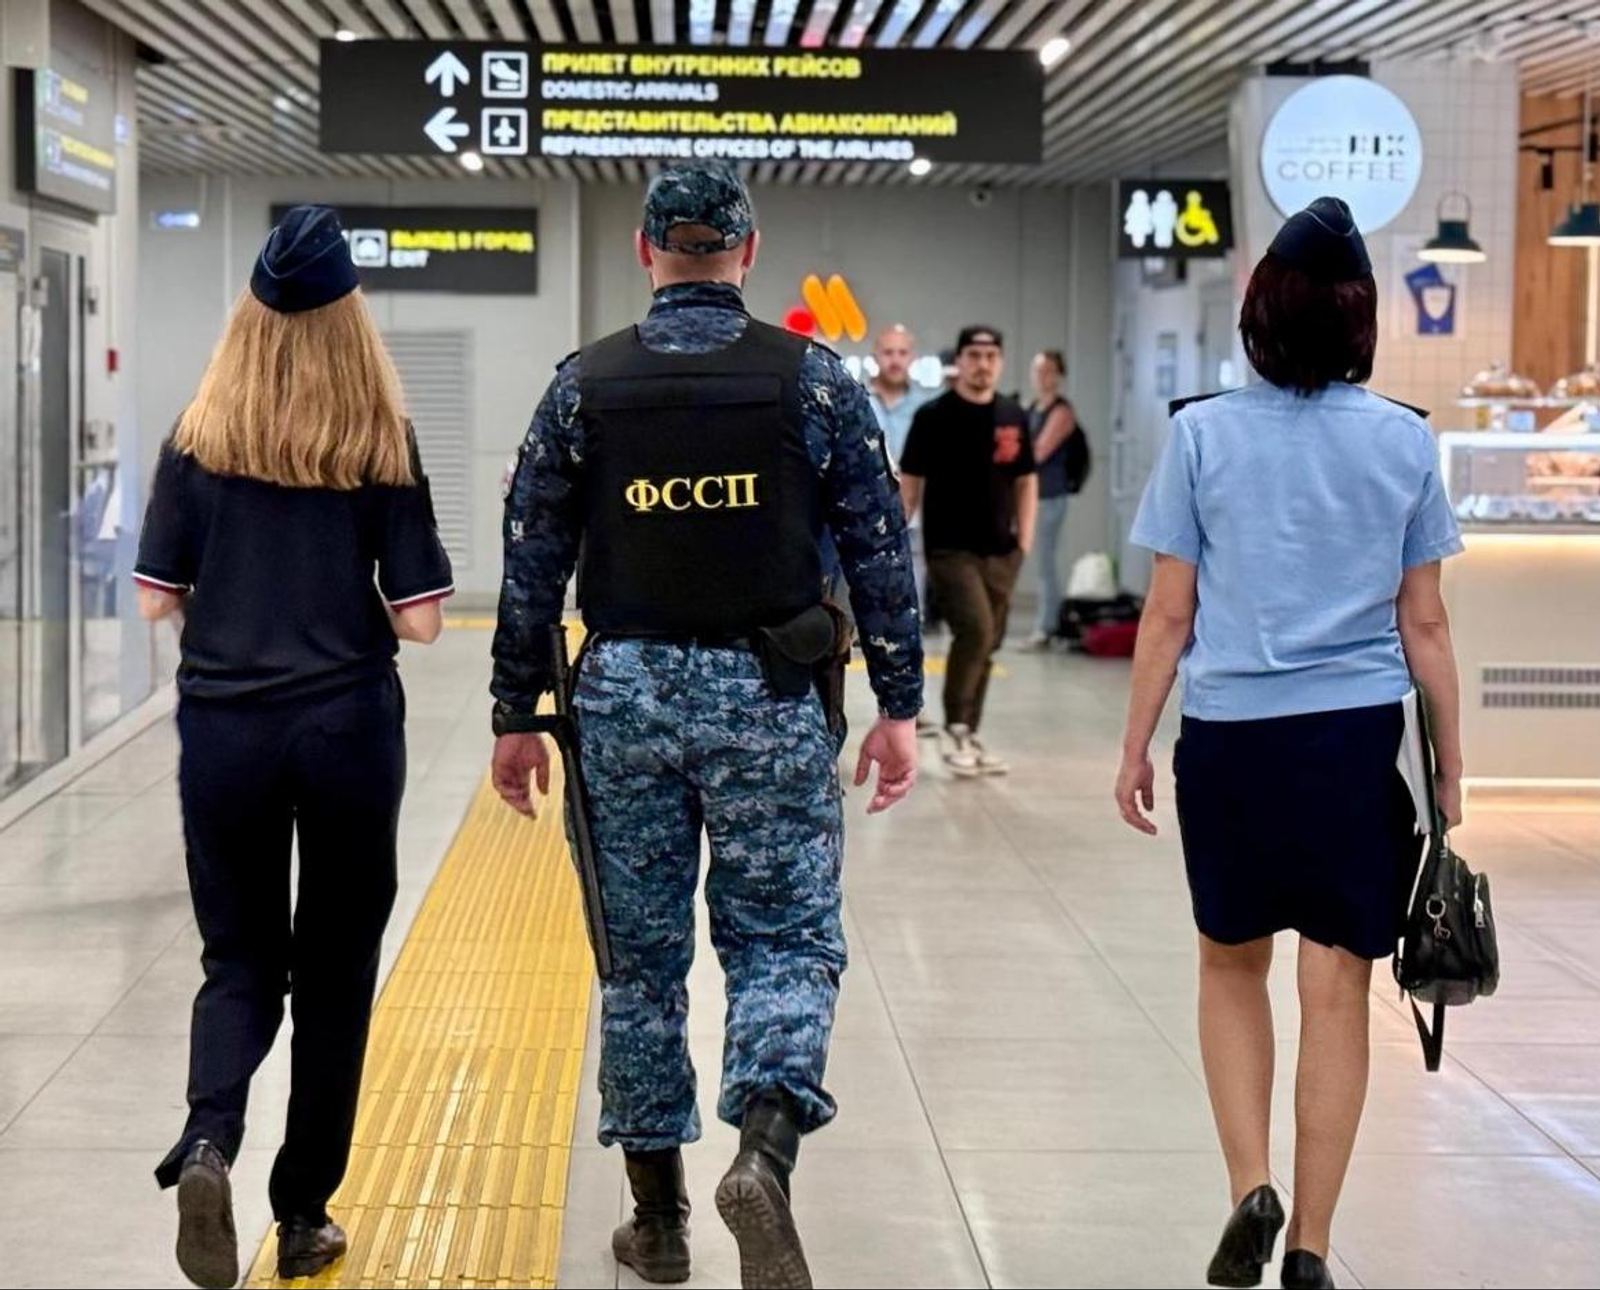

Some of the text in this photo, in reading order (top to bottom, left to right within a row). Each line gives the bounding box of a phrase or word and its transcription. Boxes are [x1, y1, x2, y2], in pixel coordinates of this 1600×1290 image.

[541, 53, 861, 78] ПРИЛЕТ ВНУТРЕННИХ РЕЙСОВ
[541, 80, 719, 101] DOMESTIC ARRIVALS
[542, 109, 957, 136] ПРЕДСТАВИТЕЛЬСТВА АВИАКОМПАНИЙ
[693, 138, 769, 158] OFFICES
[770, 139, 796, 158] OF
[798, 140, 834, 159] THE
[834, 140, 915, 160] AIRLINES
[1277, 160, 1408, 182] COFFEE
[625, 473, 760, 512] ФССП
